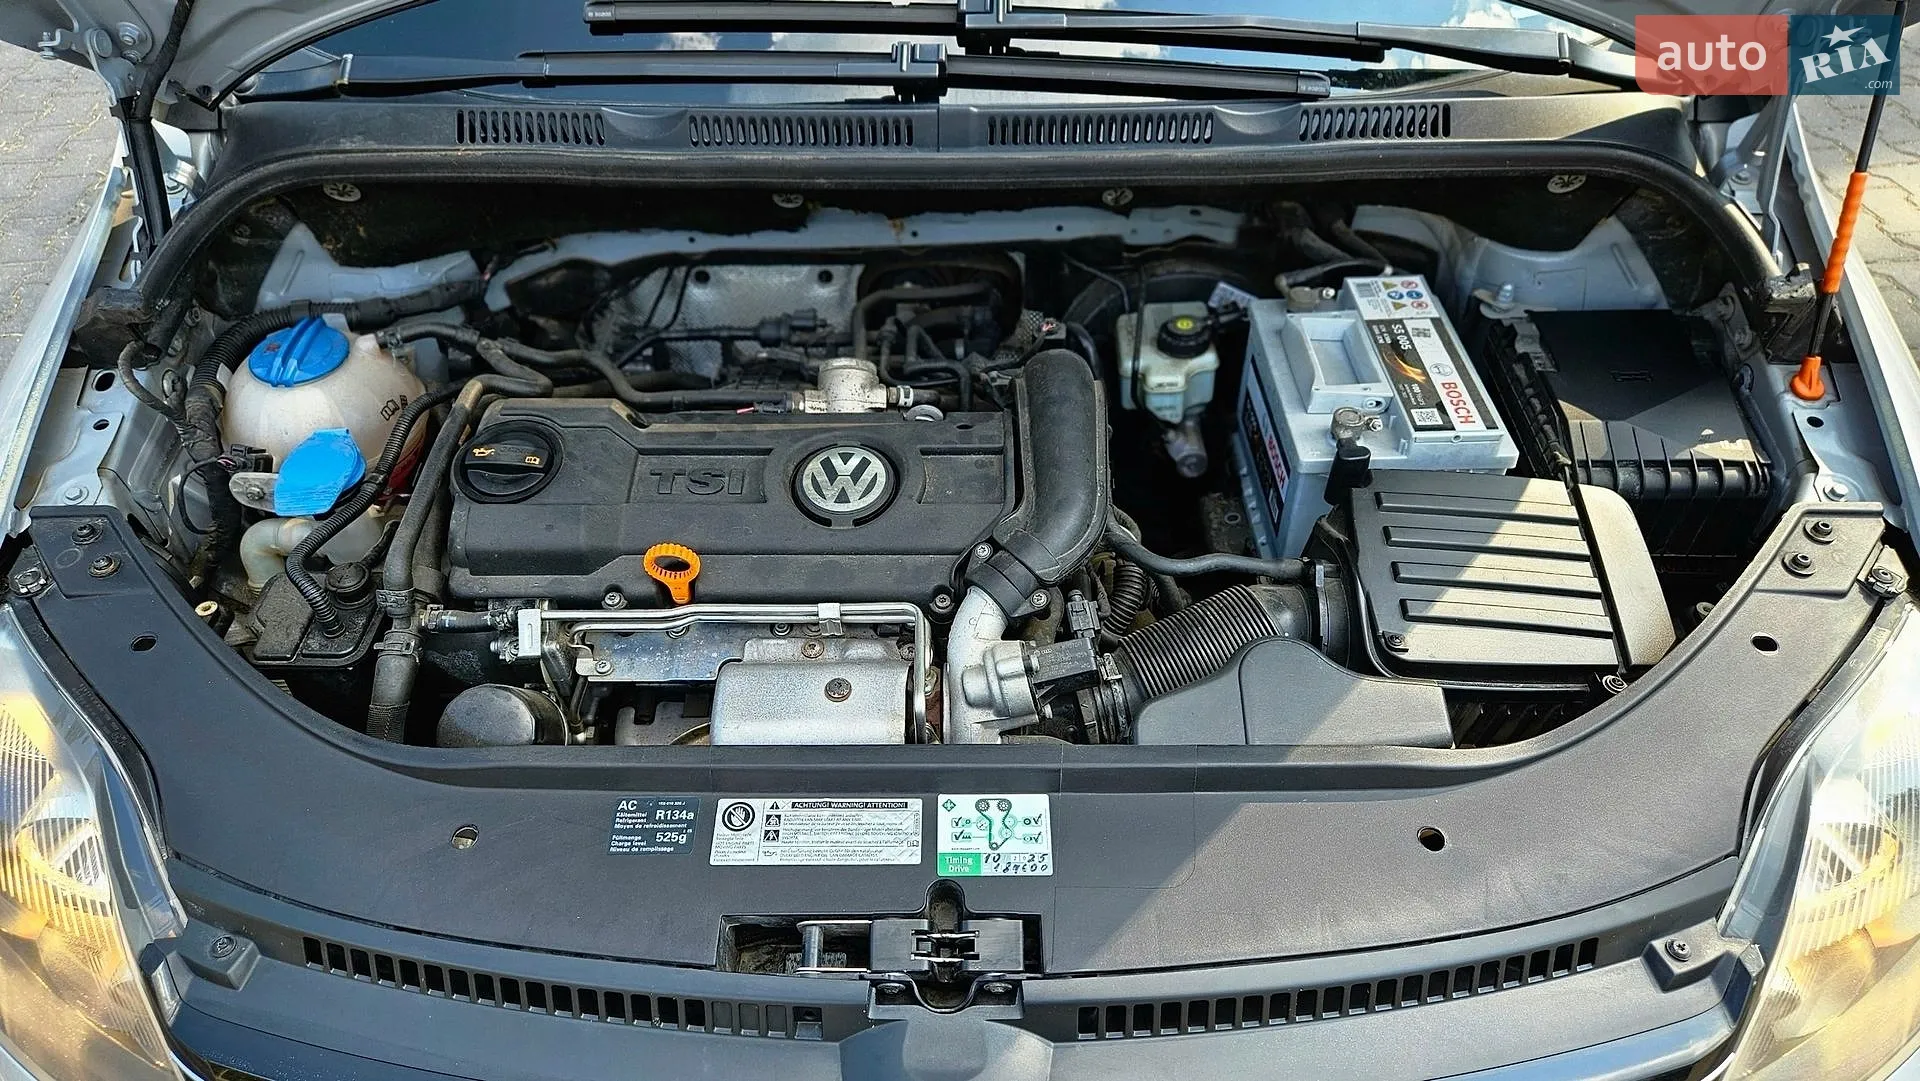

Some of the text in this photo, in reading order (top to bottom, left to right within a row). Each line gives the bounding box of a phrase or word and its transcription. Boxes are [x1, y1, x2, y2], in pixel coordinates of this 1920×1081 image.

[1396, 335, 1412, 350] 005
[1441, 382, 1476, 425] BOSCH
[649, 467, 745, 496] TSI
[617, 800, 638, 811] AC
[655, 809, 695, 820] R134a
[655, 832, 687, 844] 525g
[945, 856, 973, 865] Timing
[948, 864, 970, 873] Drive
